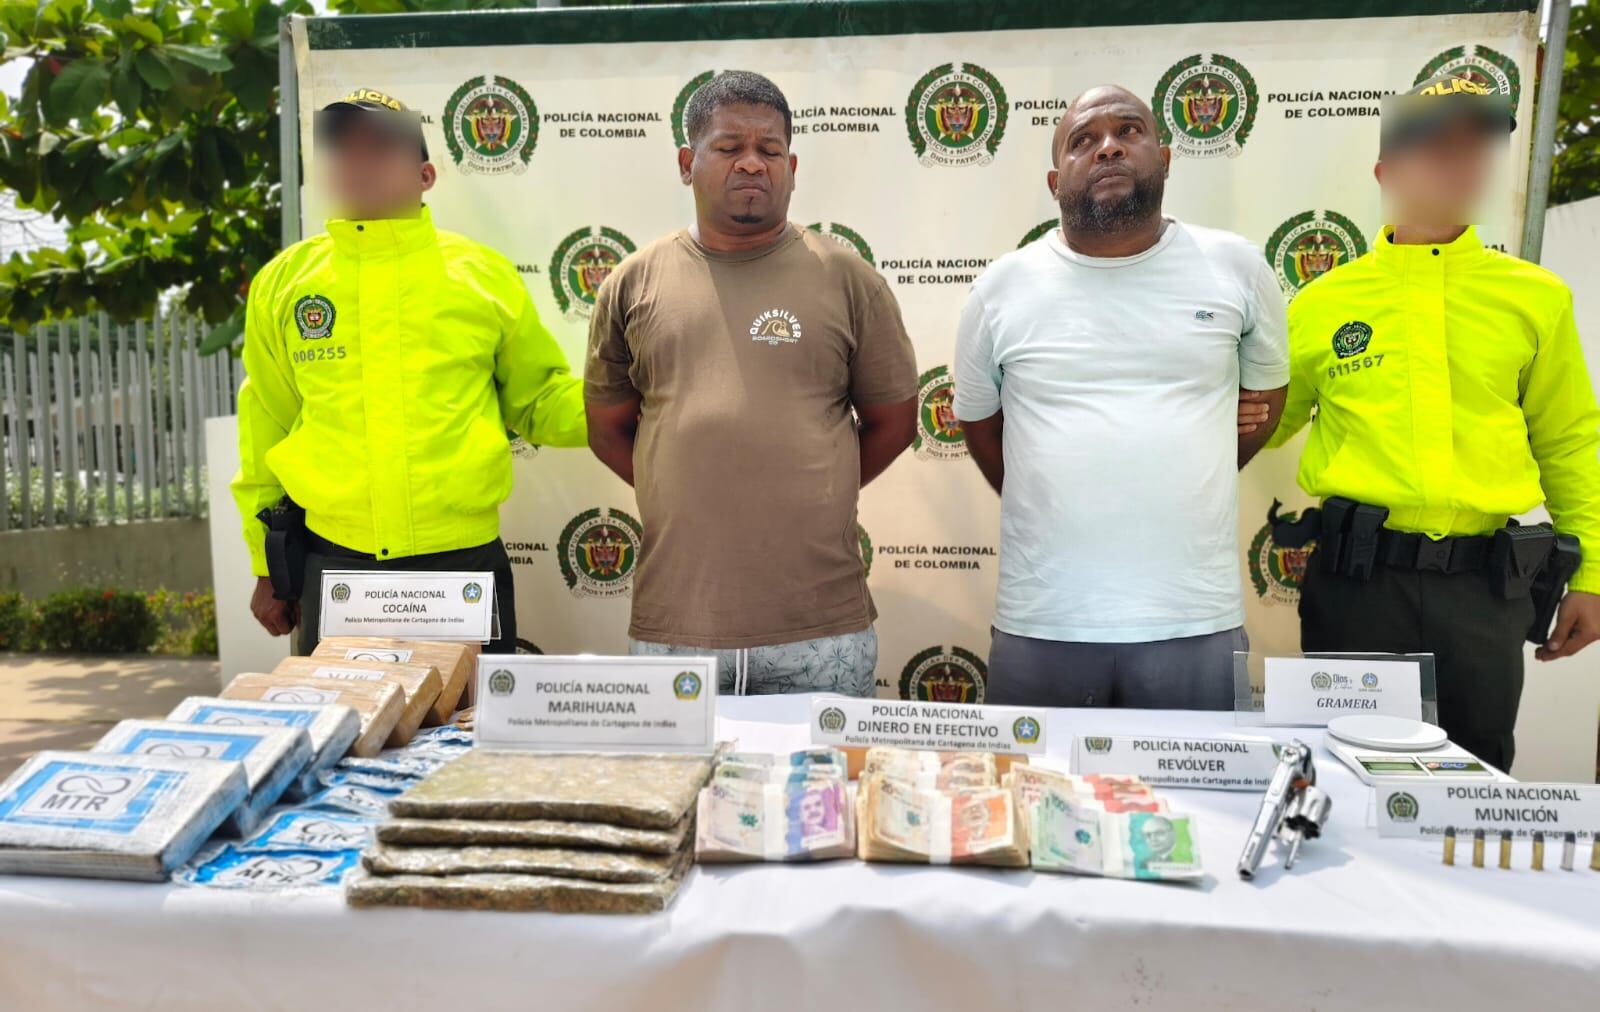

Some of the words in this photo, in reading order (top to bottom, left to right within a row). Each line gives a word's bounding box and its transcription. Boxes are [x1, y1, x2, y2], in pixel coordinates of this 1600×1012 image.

[1222, 70, 1245, 111] COLOMBIA
[1268, 90, 1324, 102] POLICÍA
[972, 80, 995, 120] COLOMBIA
[1015, 98, 1068, 111] POLICÍA
[544, 111, 593, 123] POLICÍA
[597, 112, 662, 122] NACIONAL
[793, 106, 826, 119] LICÍA
[830, 107, 896, 117] NACIONAL
[1285, 109, 1303, 119] DE
[1307, 107, 1380, 117] COLOMBIA
[1032, 117, 1048, 126] DE
[560, 129, 575, 138] DE
[579, 128, 647, 138] COLOMBIA
[792, 125, 808, 134] DE
[812, 123, 880, 132] COLOMBIA
[1334, 227, 1356, 259] COLOMB
[881, 257, 932, 269] POLICÍA
[936, 258, 994, 269] NACION
[897, 276, 914, 284] DE
[919, 275, 977, 284] COLOMB
[749, 309, 802, 338] QUIKSILVER
[293, 346, 346, 363] 008255
[1328, 354, 1384, 379] 611567
[506, 542, 549, 551] CIONAL
[879, 544, 929, 554] POLICÍA
[932, 546, 997, 556] NACIONAL
[894, 560, 910, 568] DE
[914, 560, 980, 569] COLOMBIA
[365, 589, 398, 599] POLICÍA
[401, 590, 446, 599] NACIONAL
[382, 603, 427, 613] COCAÍNA
[536, 680, 583, 694] POLICÍA
[586, 682, 650, 694] NACIONAL
[548, 701, 636, 714] MARIHUANA
[1317, 697, 1377, 709] GRAMERA
[872, 704, 918, 718] POLICÍA
[921, 708, 984, 720] NACIONAL
[857, 720, 909, 734] DINERO
[913, 723, 932, 735] EN
[935, 723, 999, 738] EFECTIVO
[871, 736, 925, 746] Metropolitana
[926, 738, 935, 746] de
[937, 738, 975, 748] Cartagena
[977, 740, 987, 749] de
[1133, 739, 1179, 751] POLICÍA
[1184, 741, 1249, 753] NACIONAL
[1157, 756, 1225, 772] REVÓLVER
[1202, 776, 1241, 785] Cartagena
[1243, 777, 1252, 785] de
[1254, 777, 1270, 785] Indi
[1447, 785, 1501, 800] POLICÍA
[1506, 787, 1581, 801] NACIONAL
[40, 793, 109, 811] MTR
[1475, 805, 1559, 822] MUNICIÓN
[1420, 826, 1445, 835] Polici
[1516, 828, 1527, 836] de
[1577, 829, 1588, 838] de
